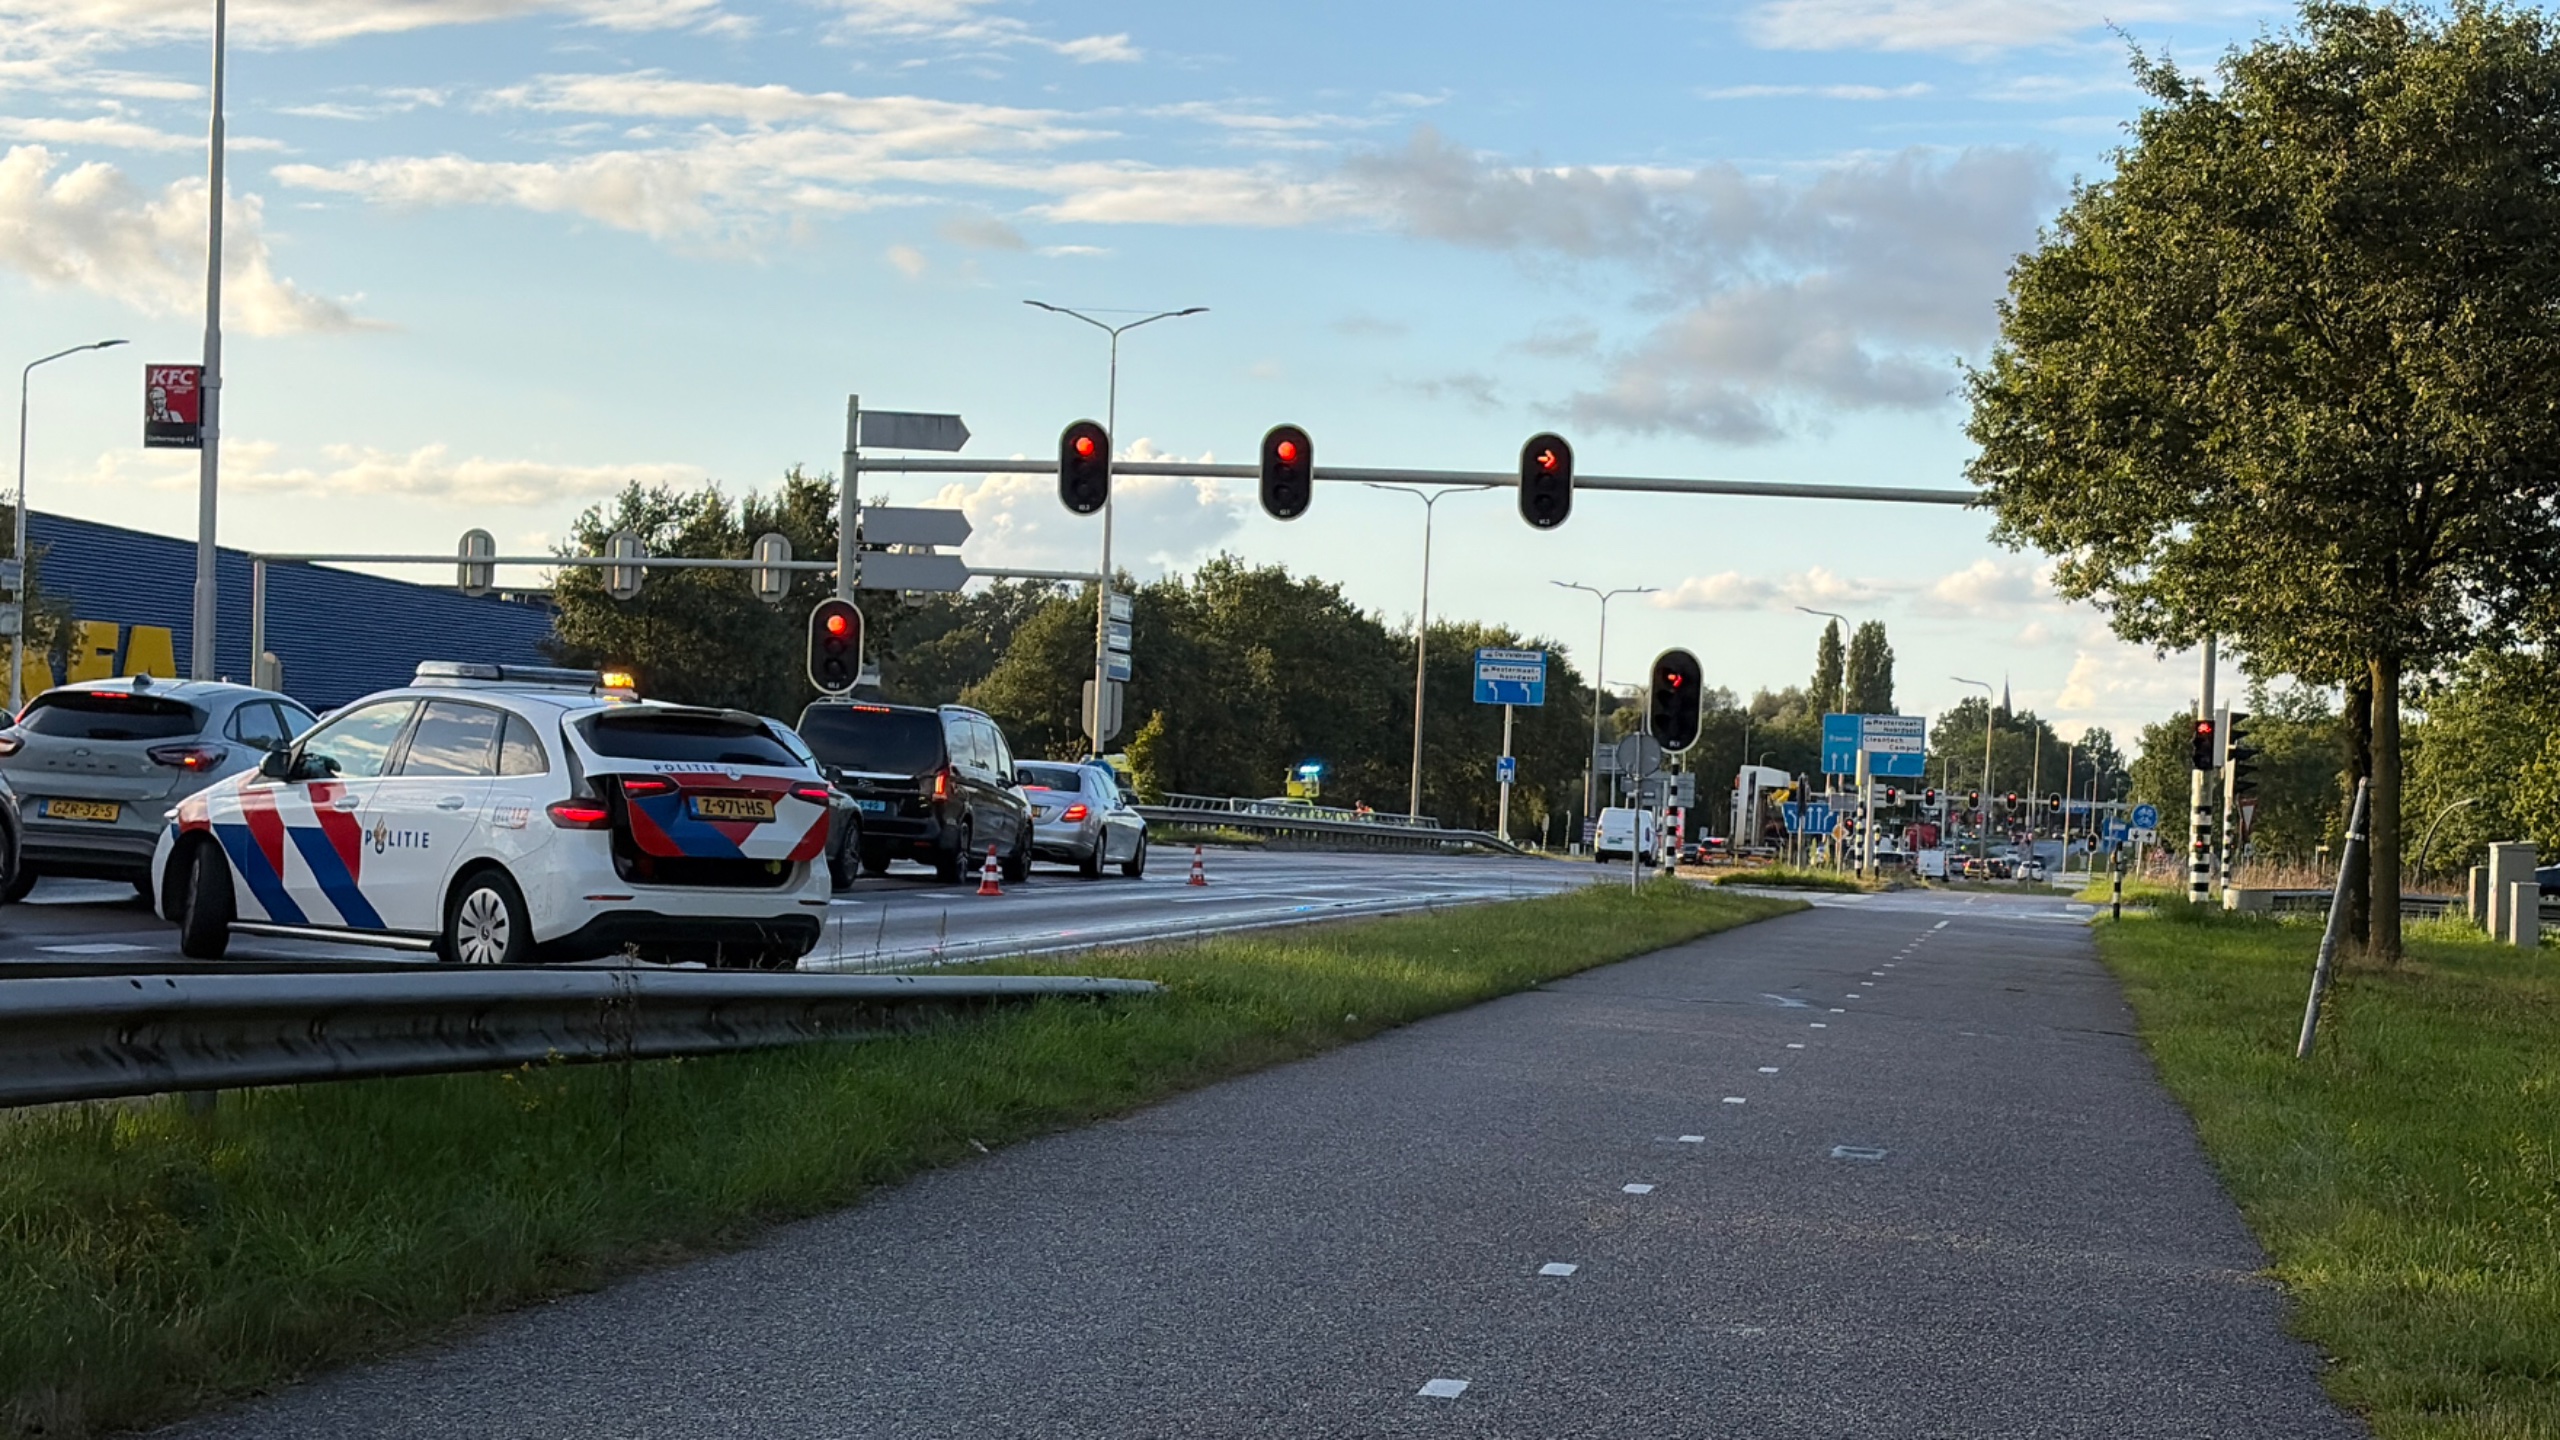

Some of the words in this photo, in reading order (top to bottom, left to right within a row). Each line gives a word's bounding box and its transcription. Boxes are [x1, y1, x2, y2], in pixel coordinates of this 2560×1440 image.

[150, 368, 194, 385] KFC
[653, 764, 720, 774] POLITIE
[704, 798, 766, 816] Z-971-HS
